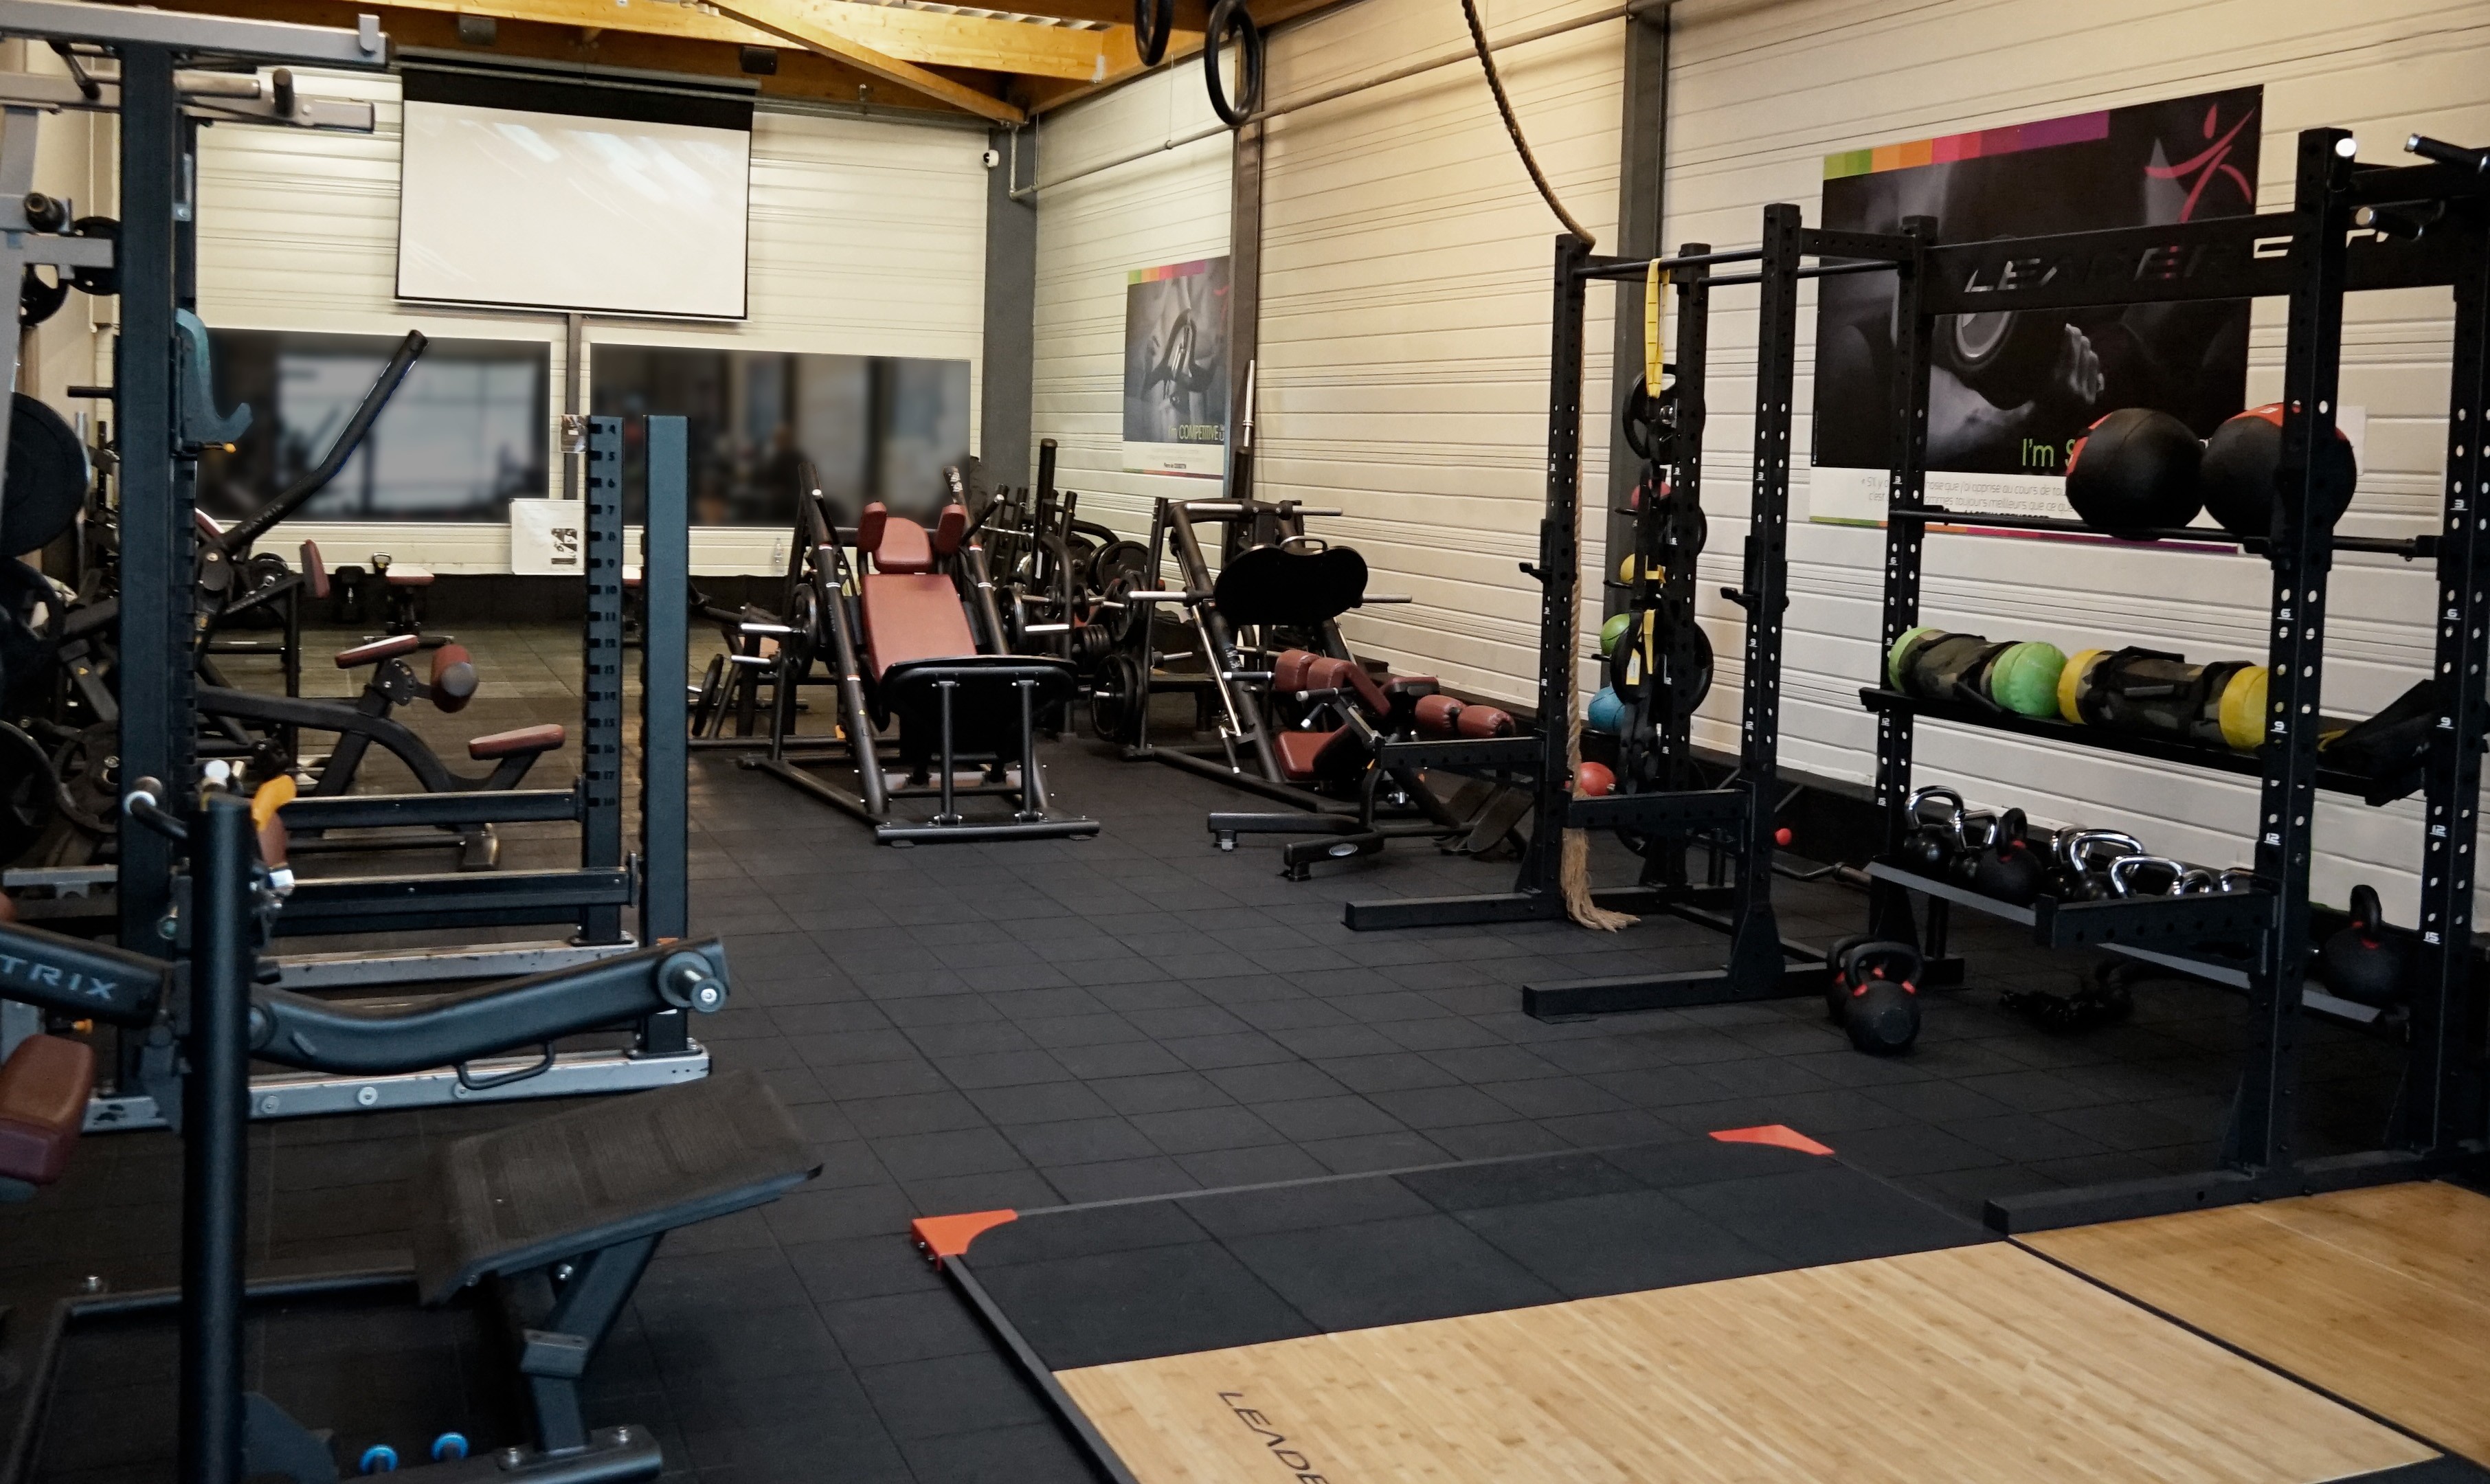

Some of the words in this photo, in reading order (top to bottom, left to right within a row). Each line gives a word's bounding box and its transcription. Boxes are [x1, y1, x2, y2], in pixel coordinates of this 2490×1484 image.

[1179, 424, 1219, 440] COMPETITIVE
[2022, 438, 2054, 467] I'm
[2454, 499, 2465, 508] 3
[2280, 608, 2291, 618] 6
[2447, 609, 2458, 618] 6
[2274, 721, 2285, 731] 9
[2440, 717, 2451, 726] 9
[2432, 825, 2447, 835] 12
[2266, 832, 2279, 842] 12
[2425, 932, 2439, 942] 15
